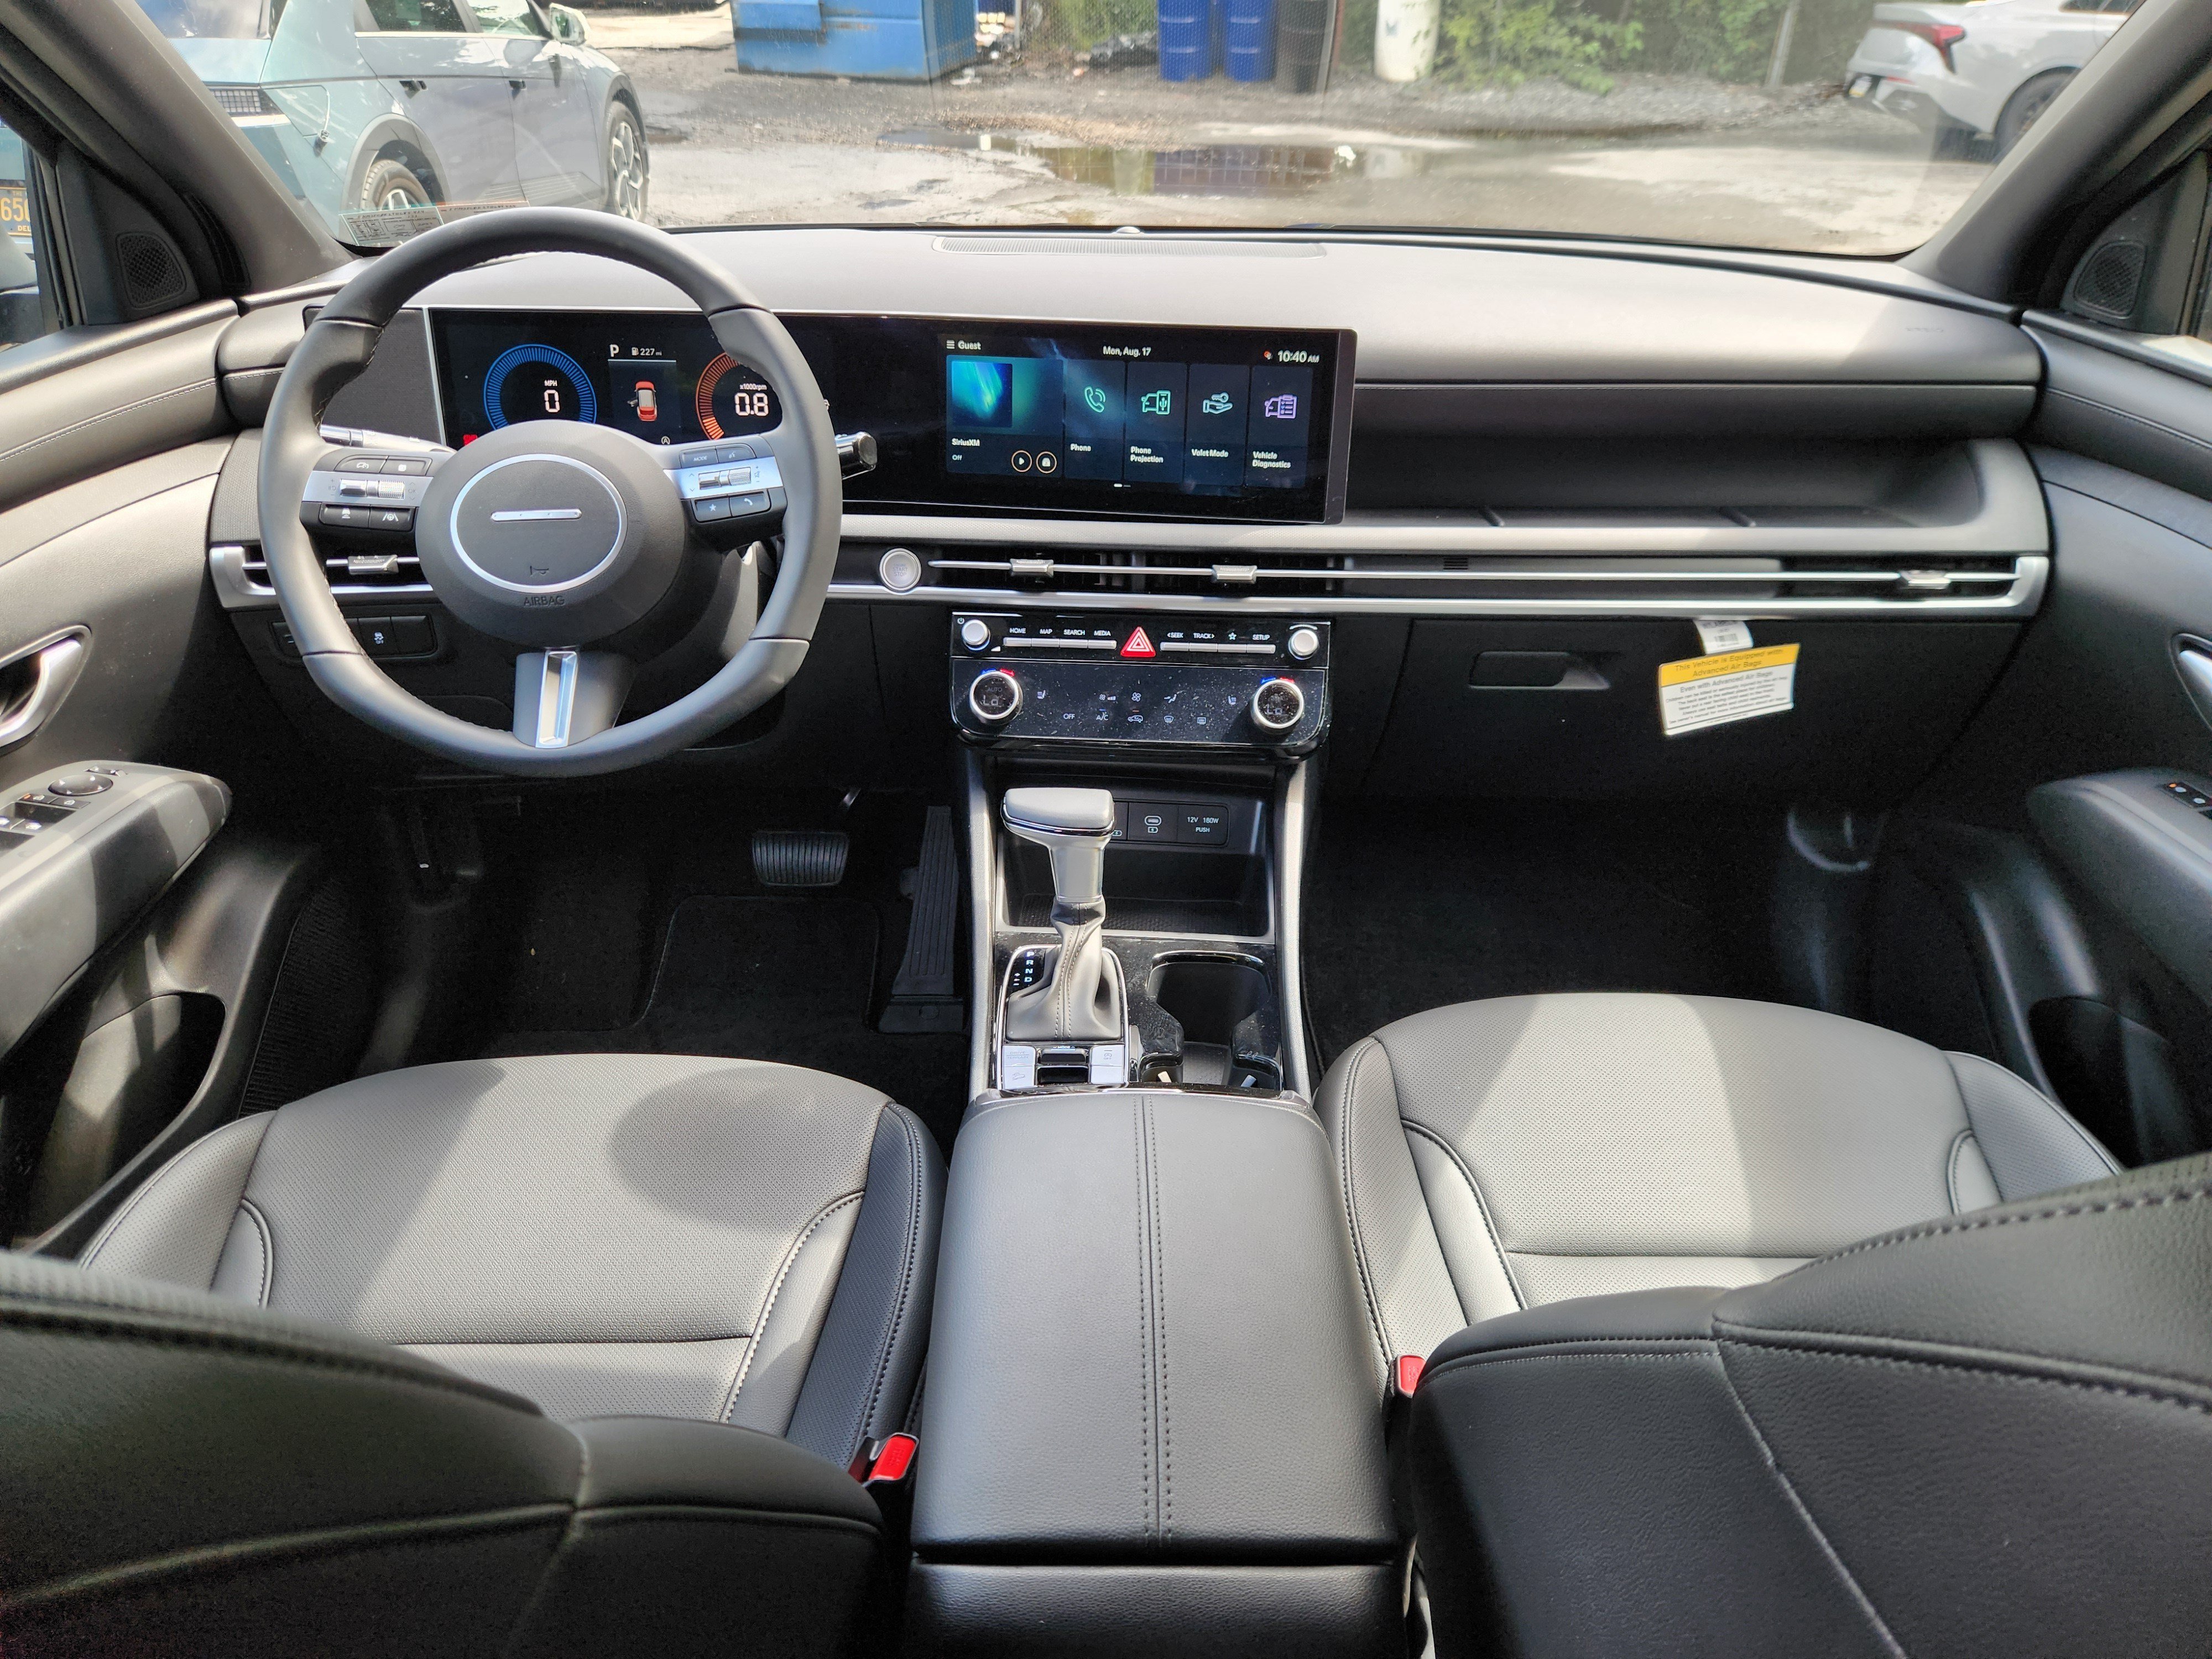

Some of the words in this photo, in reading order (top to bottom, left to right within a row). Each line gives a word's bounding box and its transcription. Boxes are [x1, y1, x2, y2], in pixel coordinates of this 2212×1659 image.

[958, 340, 981, 350] Guest
[609, 344, 619, 357] P
[1103, 346, 1122, 356] Mon,
[1123, 346, 1140, 357] Aug.
[1142, 347, 1151, 356] 17
[1277, 349, 1307, 363] 10:40
[1307, 354, 1320, 363] AM
[544, 389, 560, 413] 0
[734, 392, 769, 416] 0.8
[952, 437, 980, 446] SiriusXM
[1070, 443, 1092, 451] Phone
[1130, 446, 1152, 454] Phone
[1191, 448, 1209, 457] Valet
[1209, 449, 1229, 457] Mode
[1253, 451, 1278, 460] Vehicle
[1130, 454, 1164, 463] Projection
[1252, 460, 1291, 468] Diagnostics
[524, 596, 565, 606] AIRBAG
[1693, 659, 1719, 667] Vehicle
[1730, 651, 1765, 662] Equipped
[1693, 665, 1729, 677] Advanced
[1096, 712, 1109, 721] A/C
